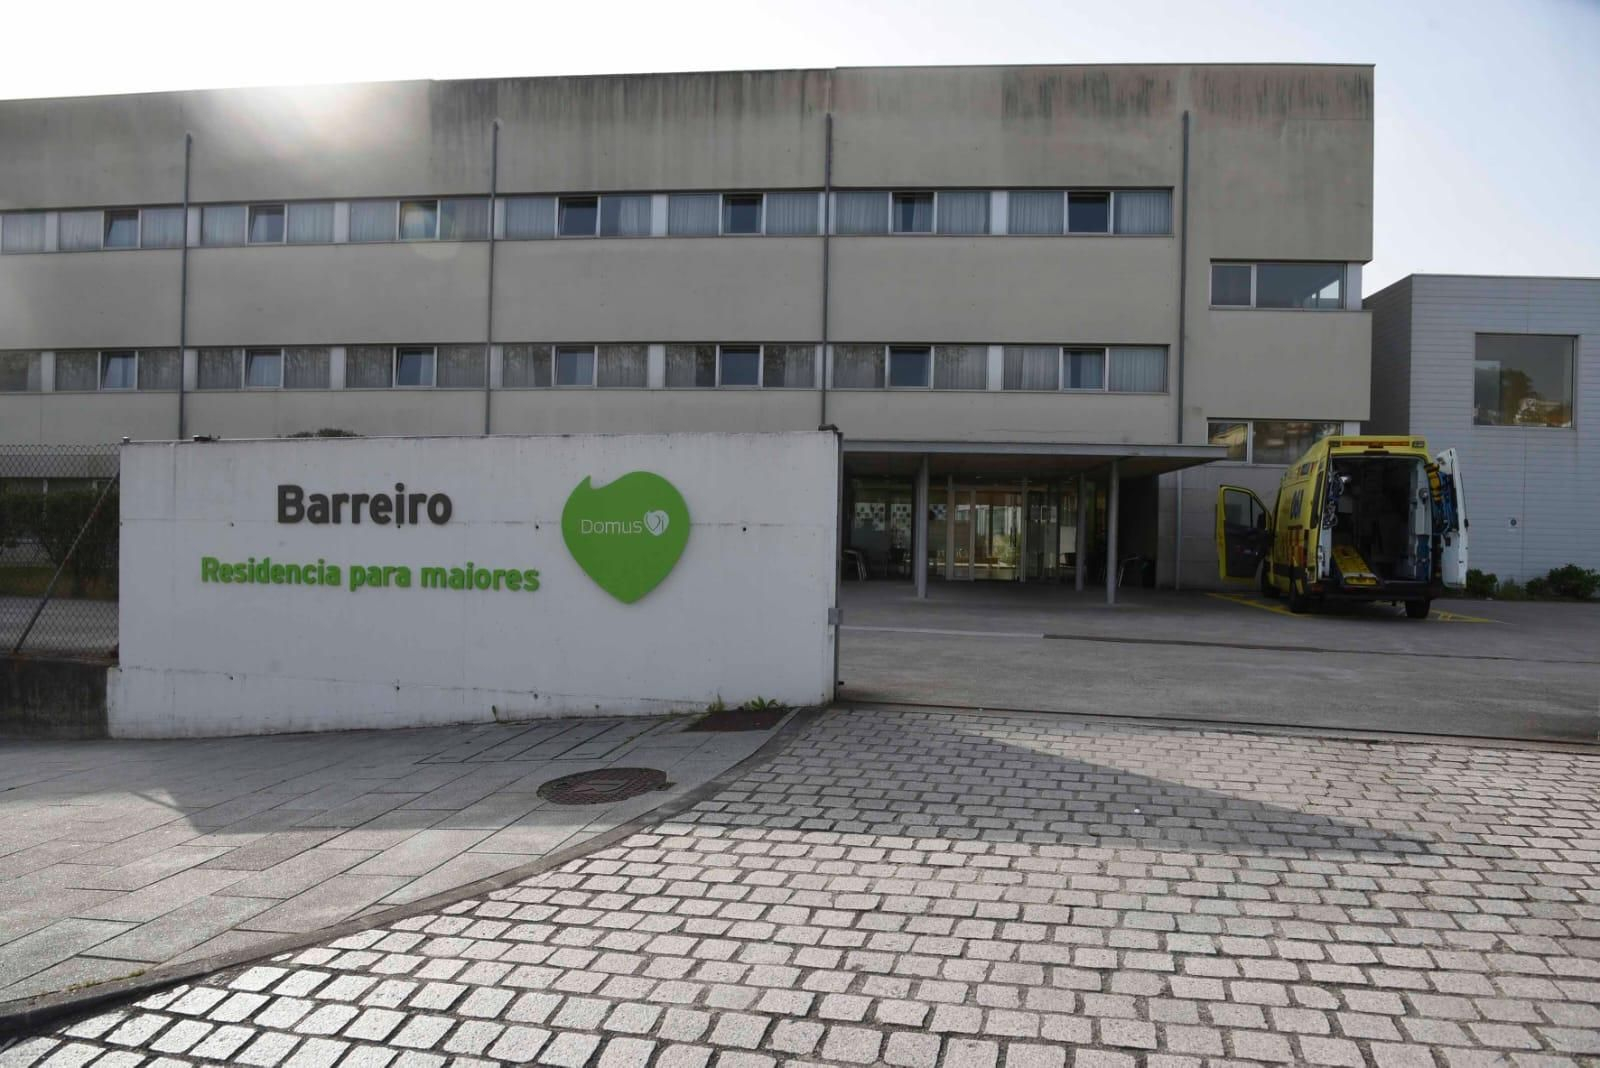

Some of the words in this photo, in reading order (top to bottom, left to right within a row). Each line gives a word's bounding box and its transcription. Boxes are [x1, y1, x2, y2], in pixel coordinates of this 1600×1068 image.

[277, 482, 453, 526] Barreiro
[201, 557, 341, 587] Residencia
[349, 565, 411, 592] para
[420, 564, 539, 592] maiores
